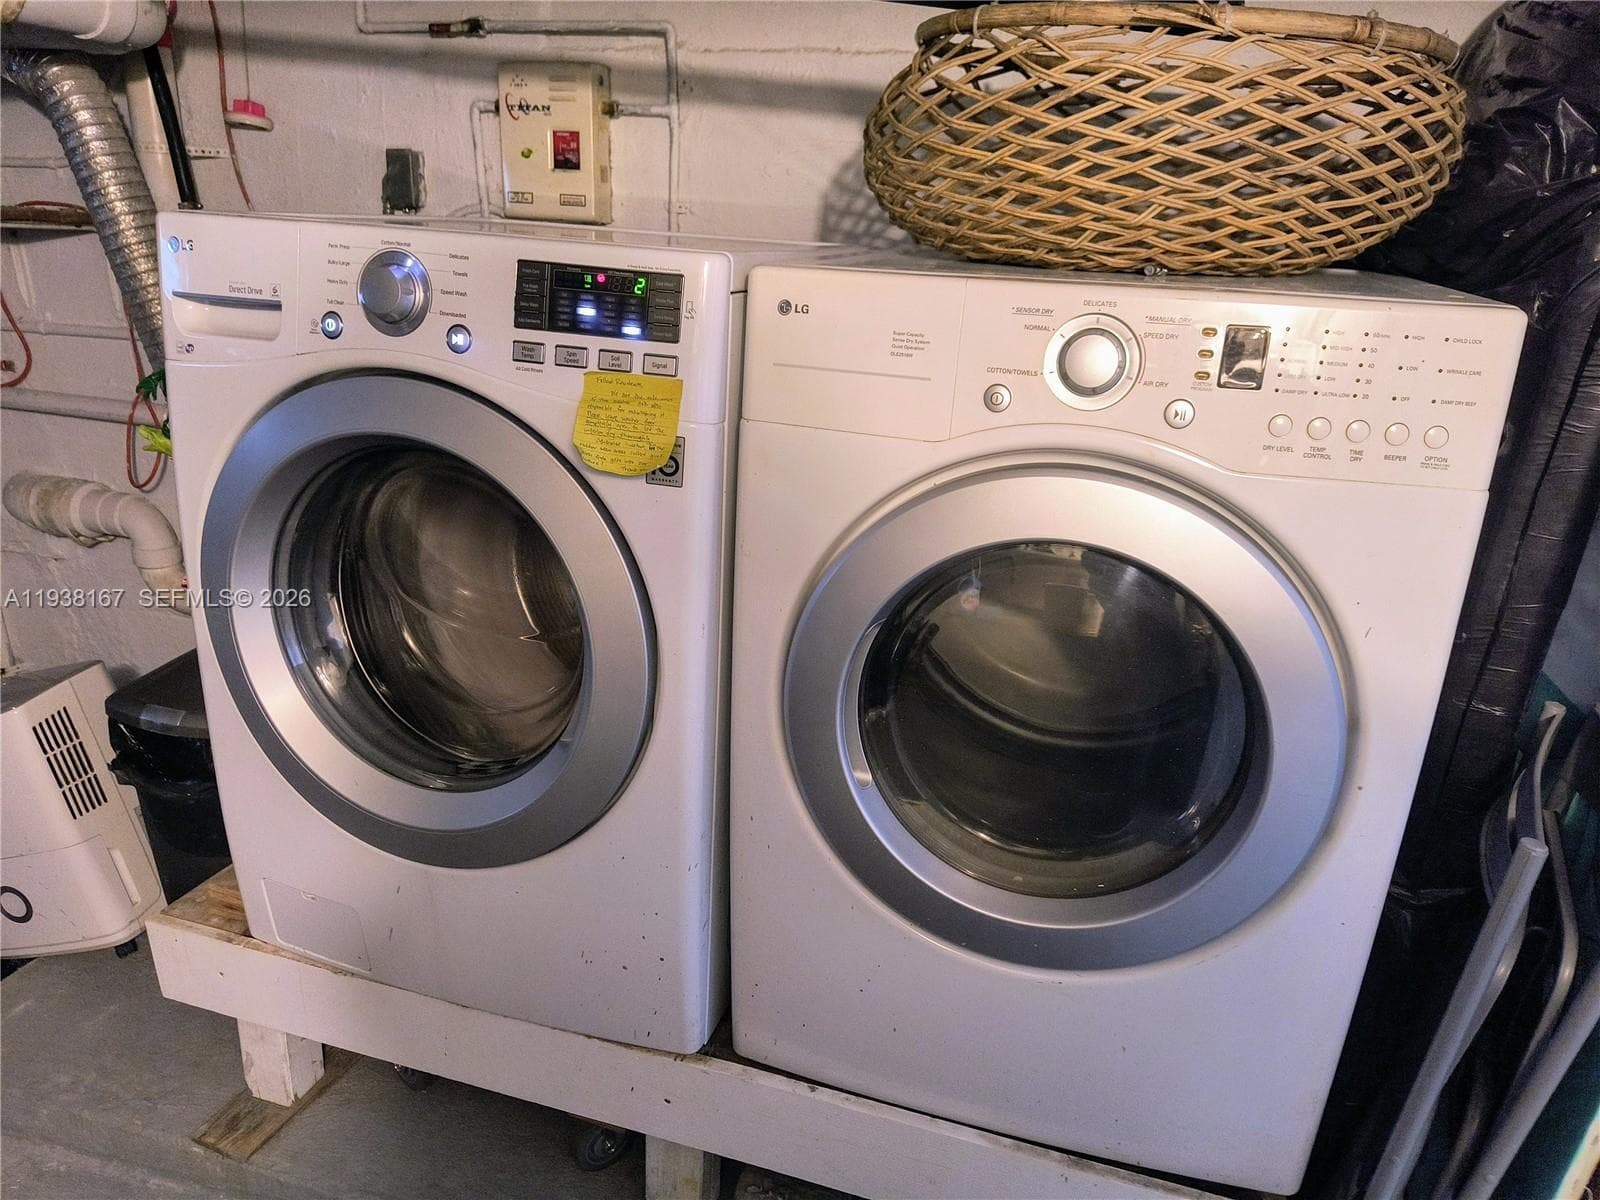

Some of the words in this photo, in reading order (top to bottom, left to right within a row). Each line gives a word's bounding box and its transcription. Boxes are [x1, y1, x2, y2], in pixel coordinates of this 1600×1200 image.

[180, 239, 194, 251] LG
[228, 284, 246, 294] Direct
[247, 286, 264, 296] Drive
[634, 278, 646, 294] 2
[440, 288, 454, 296] Speed
[1083, 300, 1118, 308] DELICATES
[794, 303, 810, 314] LG
[1015, 306, 1041, 314] SENSOR
[439, 310, 467, 318] Downloaded
[1024, 324, 1051, 332] NORMAL
[652, 362, 668, 370] Signal
[986, 366, 1038, 376] COTTON/TOWELS
[1276, 445, 1295, 453] LEVEL
[1302, 452, 1332, 460] CONTROL
[1384, 454, 1407, 462] BEEPER
[1424, 455, 1449, 464] OPTION
